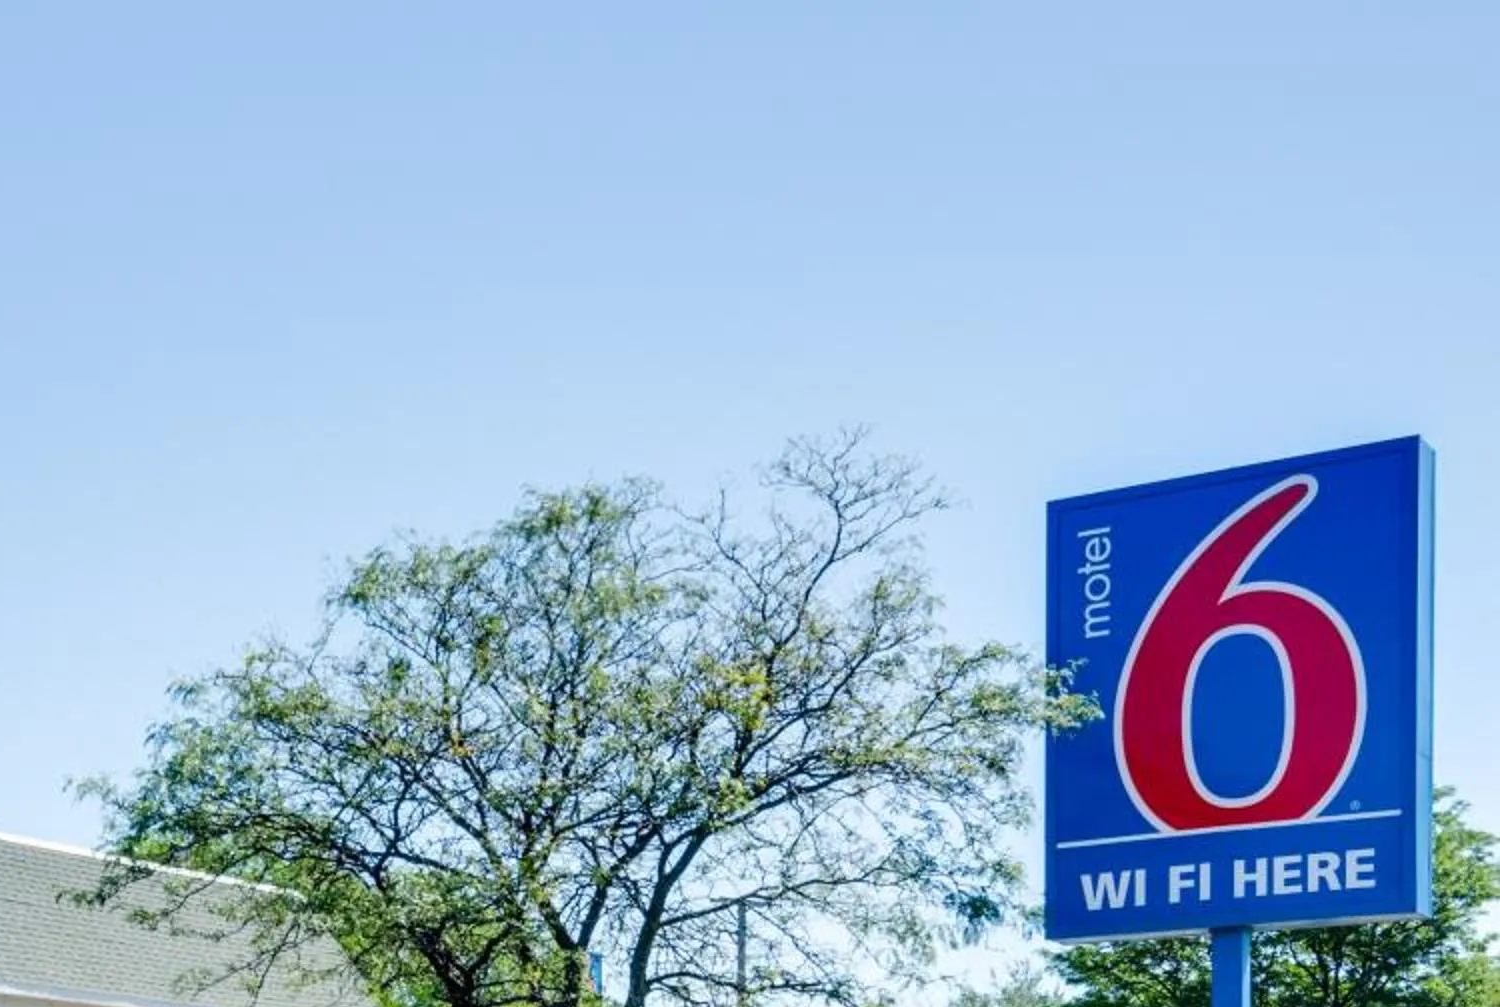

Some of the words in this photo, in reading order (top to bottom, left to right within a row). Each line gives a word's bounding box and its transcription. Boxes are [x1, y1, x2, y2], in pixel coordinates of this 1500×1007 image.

[1077, 526, 1111, 638] motel
[1113, 473, 1366, 834] 6
[1080, 869, 1146, 911] WI
[1168, 862, 1211, 903] FI
[1234, 848, 1376, 898] HERE
